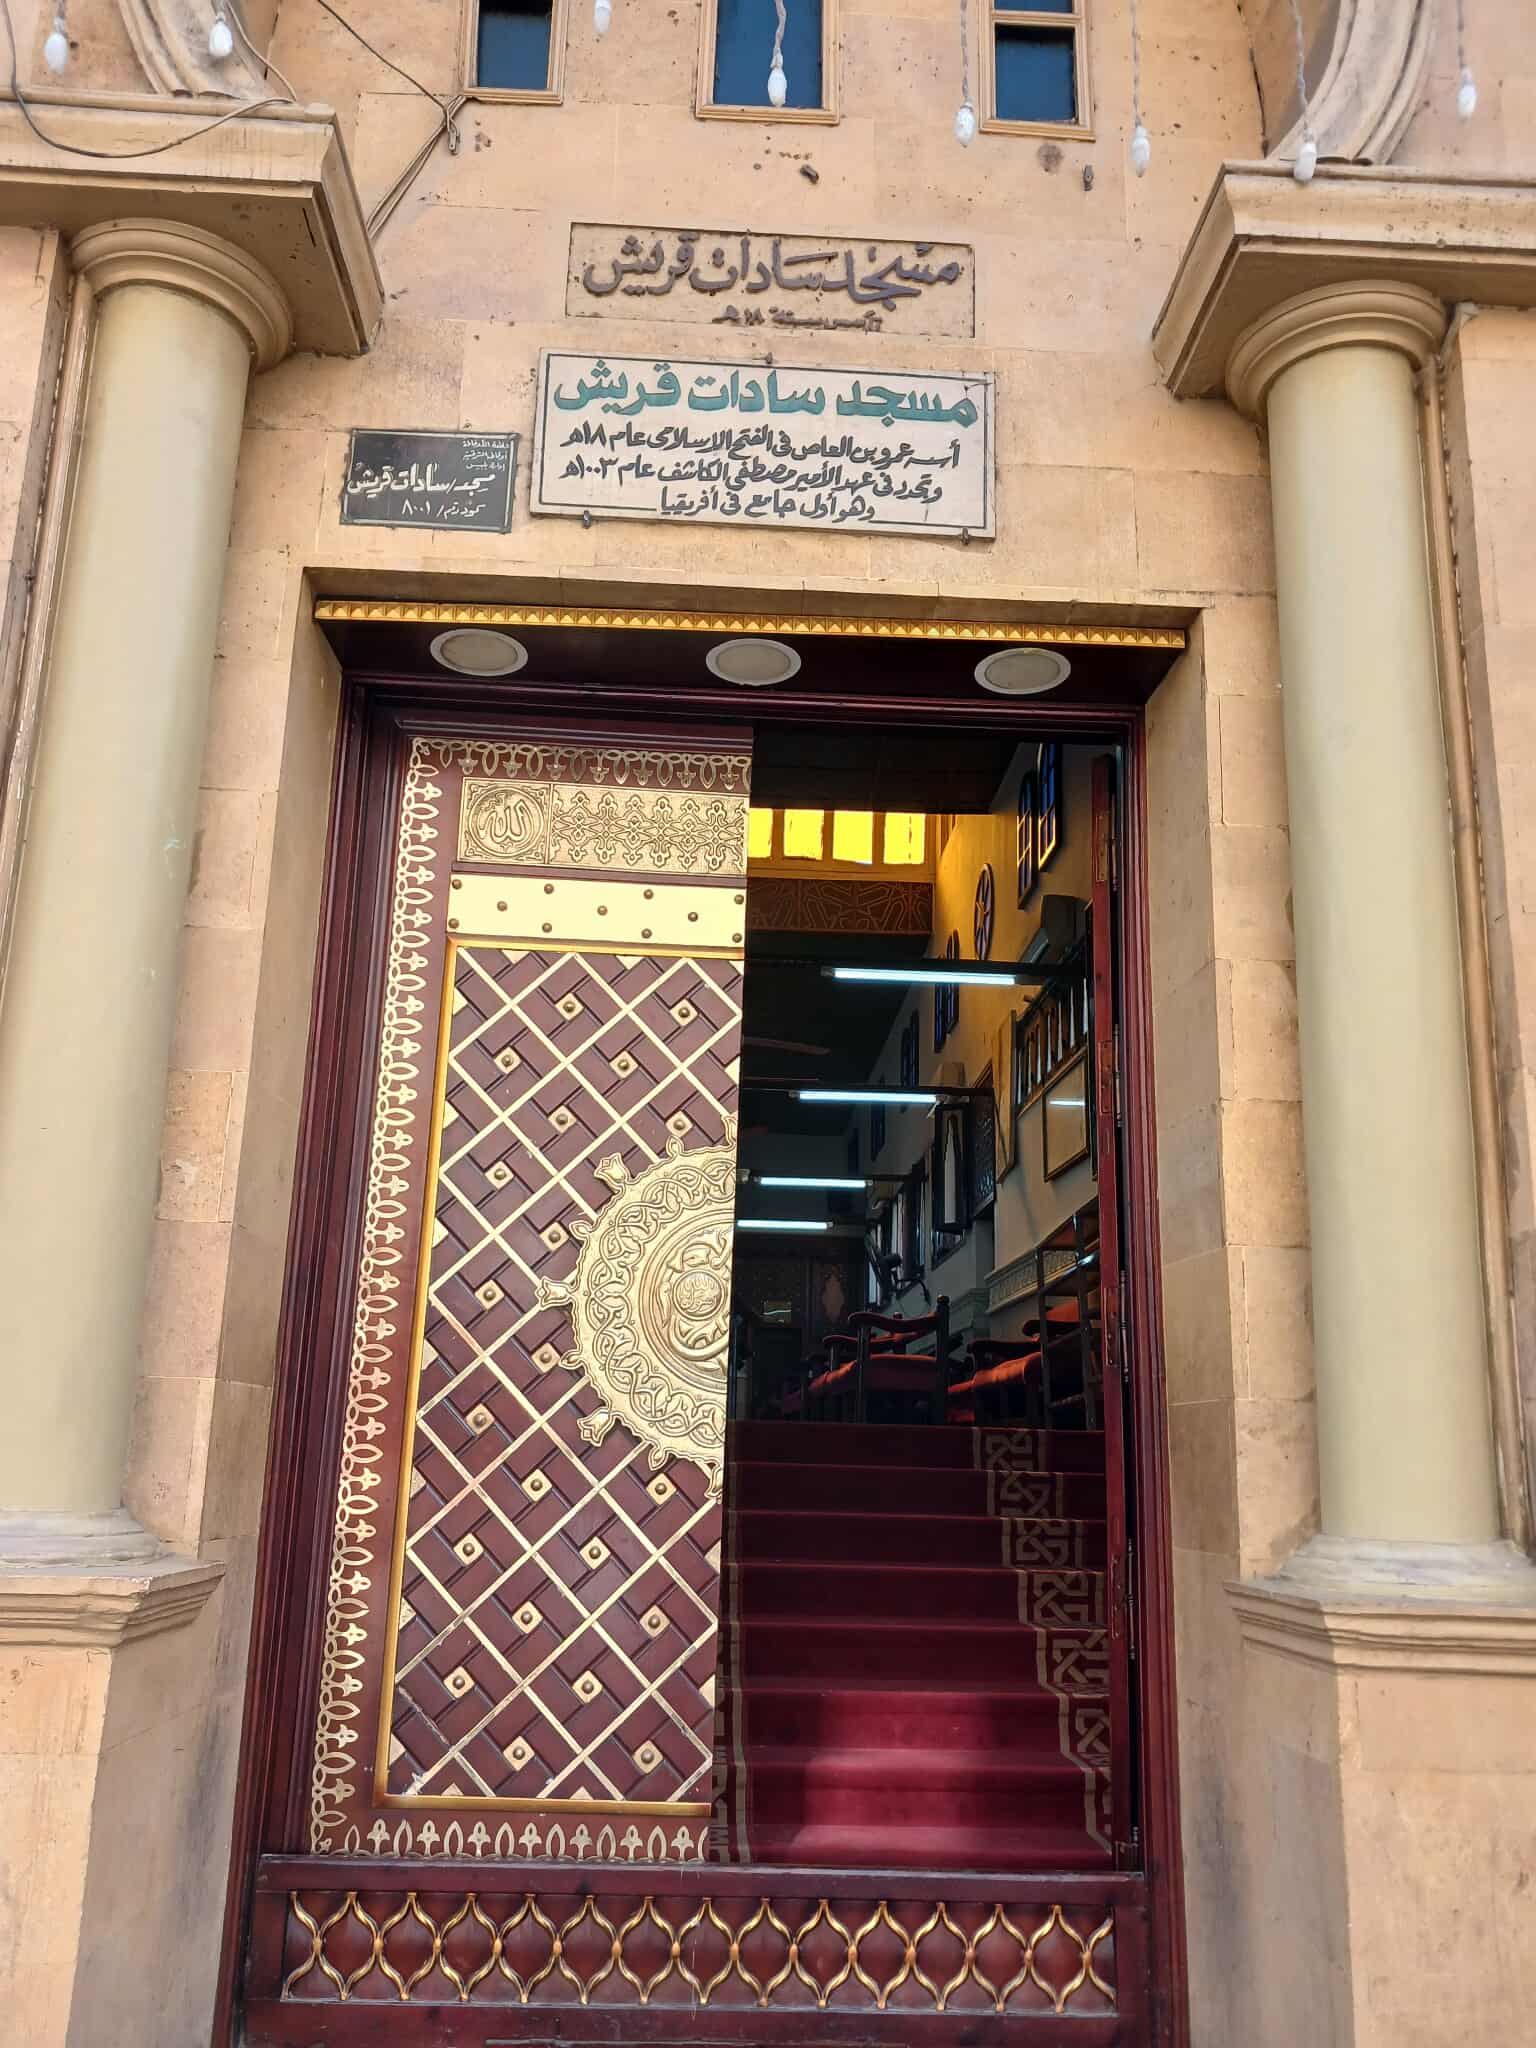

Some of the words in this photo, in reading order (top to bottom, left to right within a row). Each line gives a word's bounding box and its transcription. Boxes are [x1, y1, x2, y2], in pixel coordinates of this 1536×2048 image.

[583, 231, 699, 297] قريش
[688, 230, 823, 292] سادات
[822, 242, 960, 310] مسجد
[554, 359, 682, 416] قريش
[688, 369, 826, 416] سادات
[836, 379, 978, 428] مسجد
[610, 421, 647, 452] عام
[728, 424, 773, 460] الفتح
[791, 435, 853, 461] العاص
[618, 455, 656, 486] عام
[658, 459, 728, 481] الكاشف
[850, 446, 877, 464] بن
[871, 442, 915, 471] عمرو
[782, 460, 842, 491] الأمير
[831, 472, 875, 496] عهد
[744, 489, 795, 518] جامع
[800, 491, 837, 520] أول
[832, 495, 875, 523] وهو
